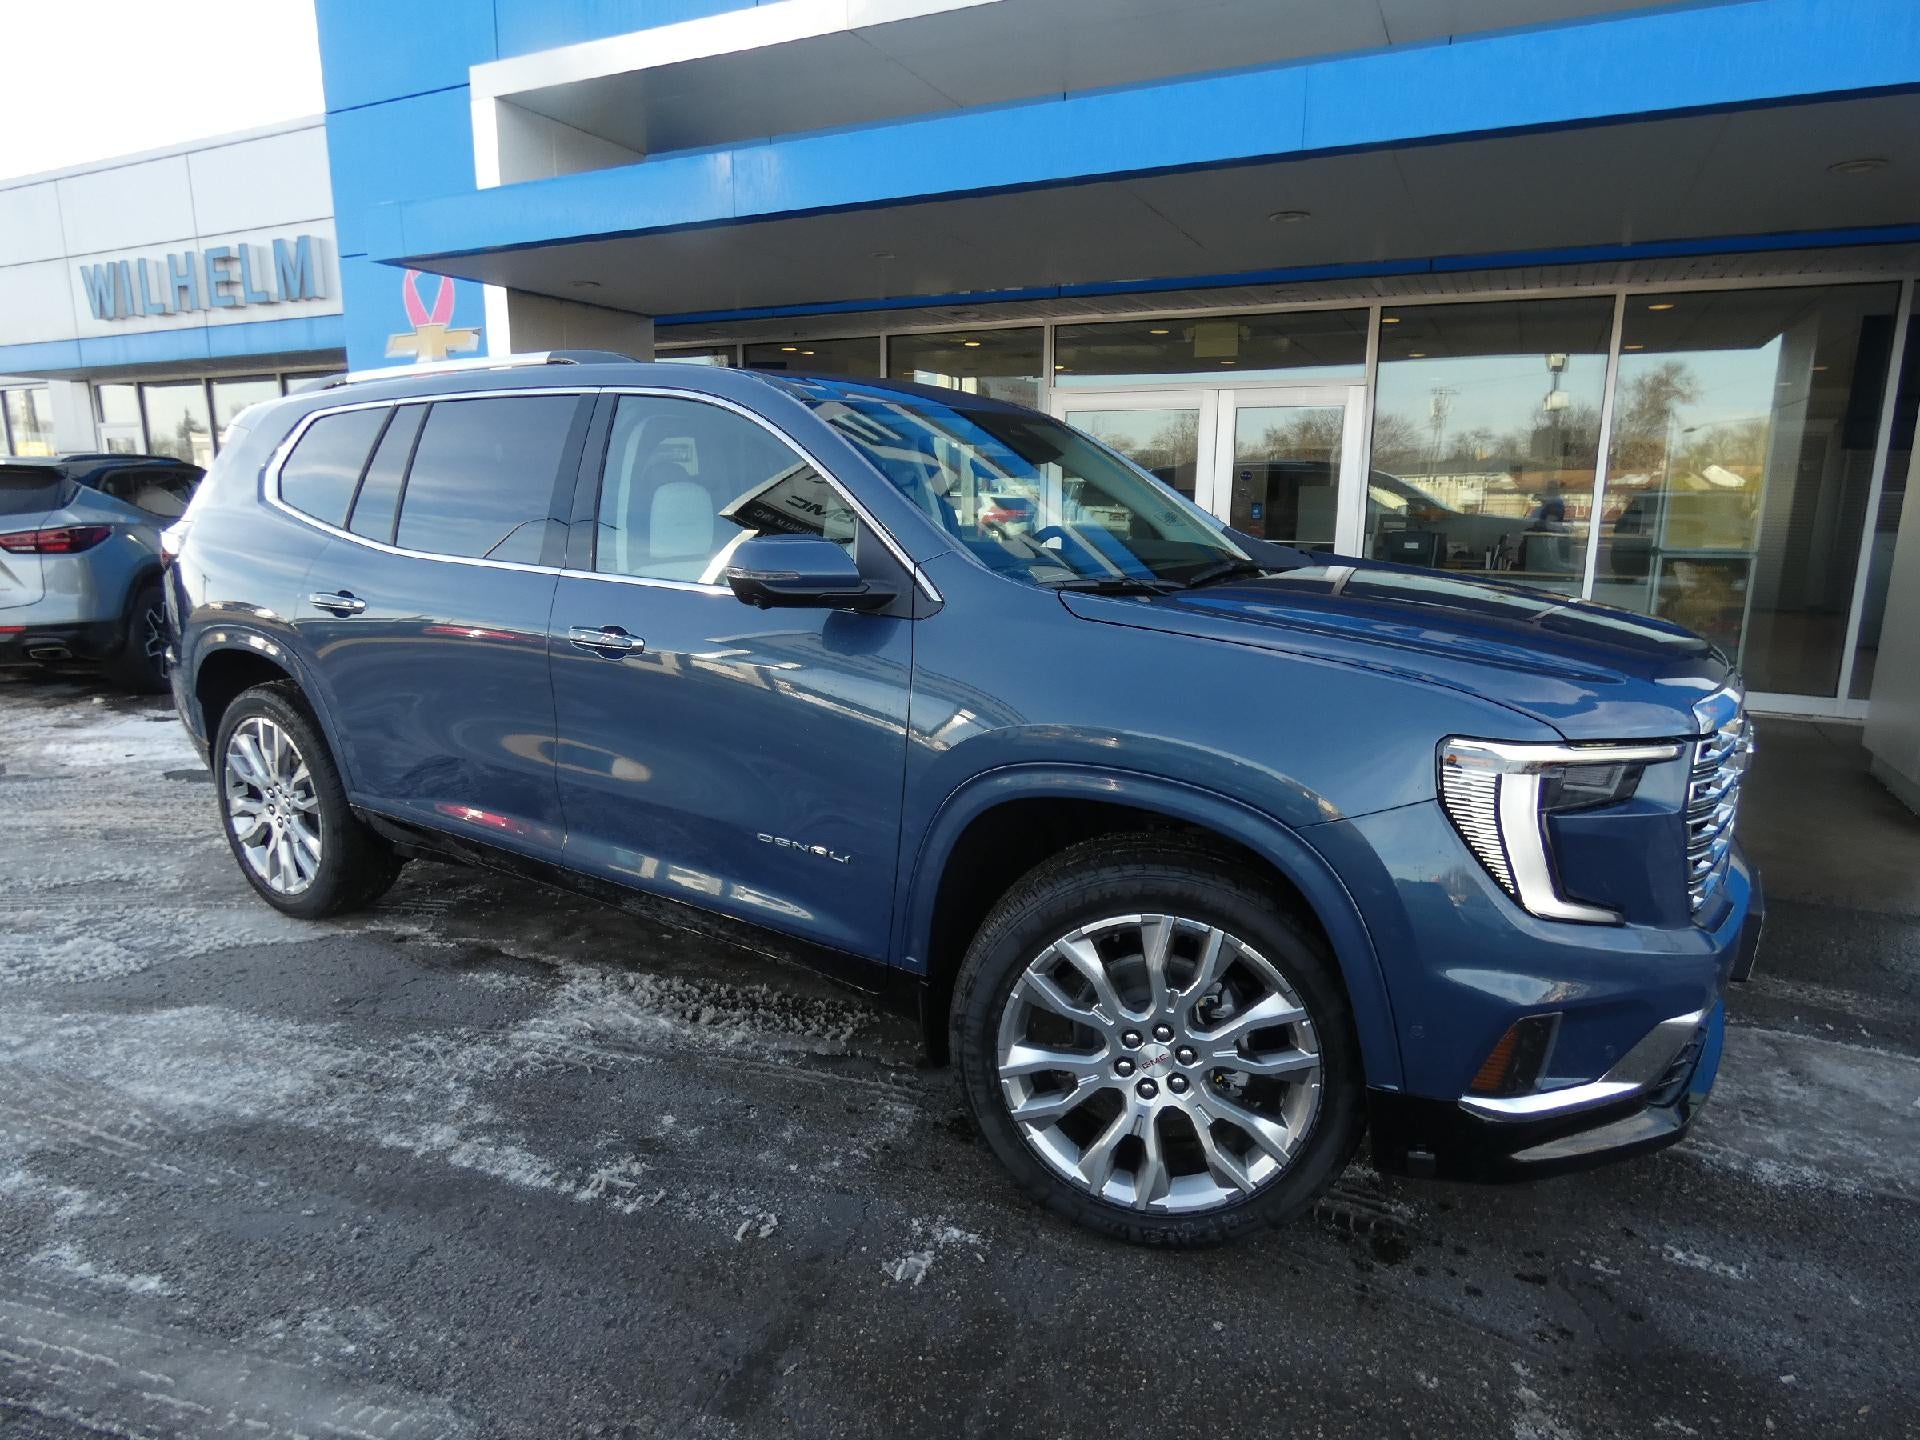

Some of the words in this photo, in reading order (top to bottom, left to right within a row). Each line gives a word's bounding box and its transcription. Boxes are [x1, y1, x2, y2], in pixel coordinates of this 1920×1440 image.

[79, 235, 319, 321] WILHELM
[757, 833, 851, 864] DENALI
[1141, 1053, 1169, 1069] GMC
